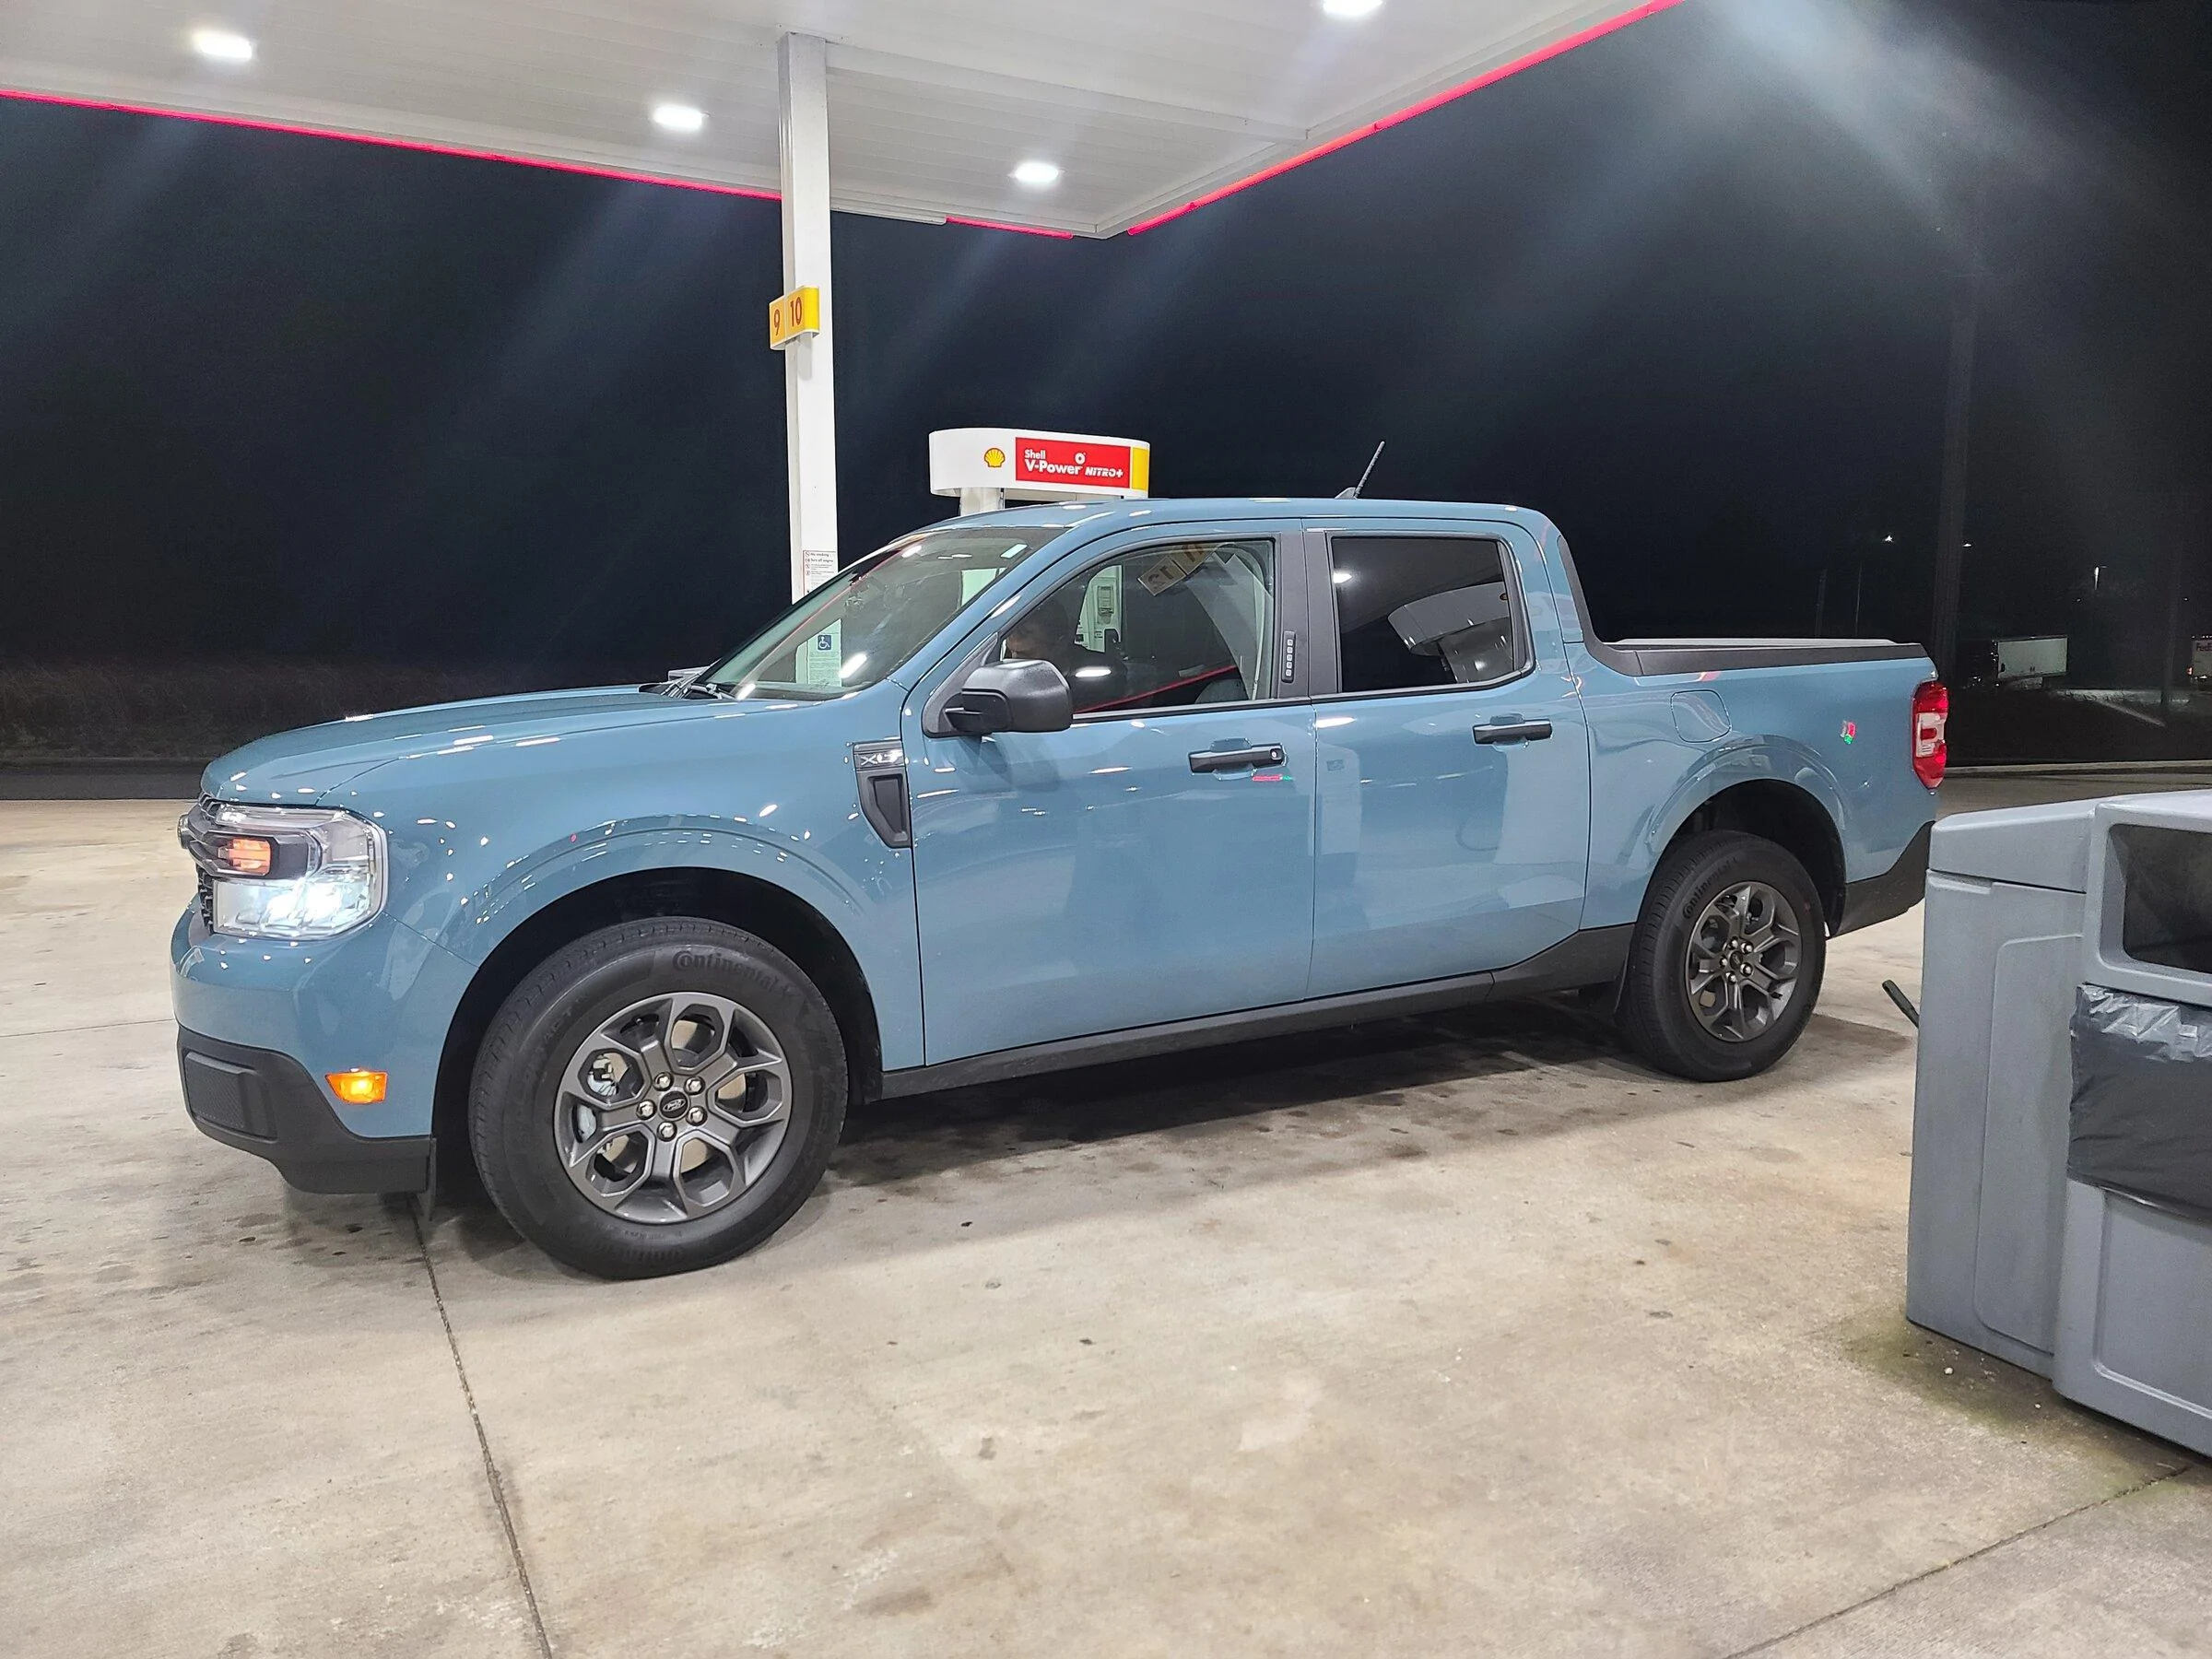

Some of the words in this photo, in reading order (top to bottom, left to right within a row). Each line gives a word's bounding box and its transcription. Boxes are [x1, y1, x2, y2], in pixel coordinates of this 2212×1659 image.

[774, 309, 781, 336] 9
[791, 297, 802, 327] 10
[1025, 449, 1046, 459] Shell
[1025, 459, 1083, 475] V-Power
[672, 950, 780, 993] Continental
